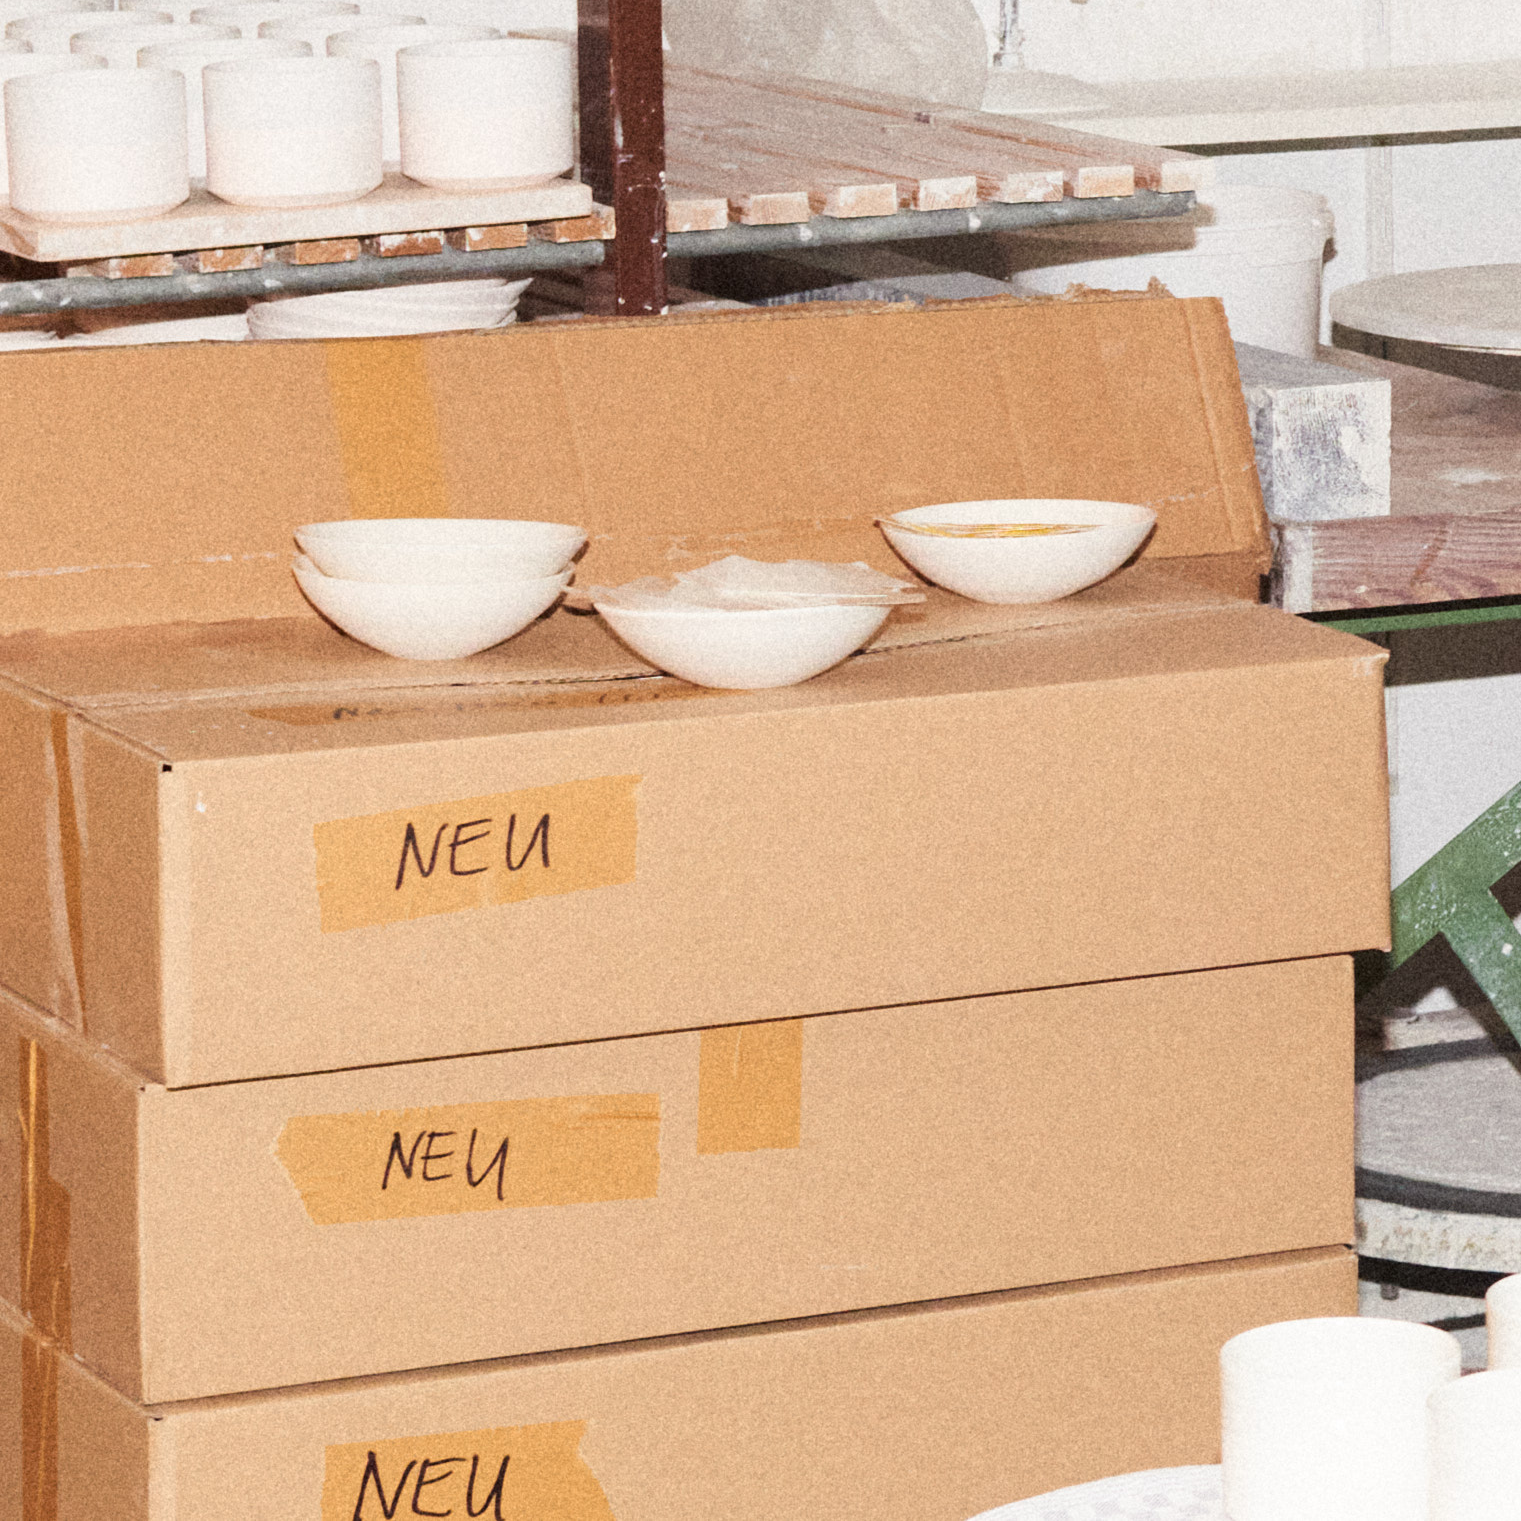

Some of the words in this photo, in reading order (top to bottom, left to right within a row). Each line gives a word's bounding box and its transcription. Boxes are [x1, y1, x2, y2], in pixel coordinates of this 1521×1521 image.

[395, 813, 550, 891] NEU
[381, 1128, 509, 1201] NEU
[352, 1450, 511, 1521] NEU
